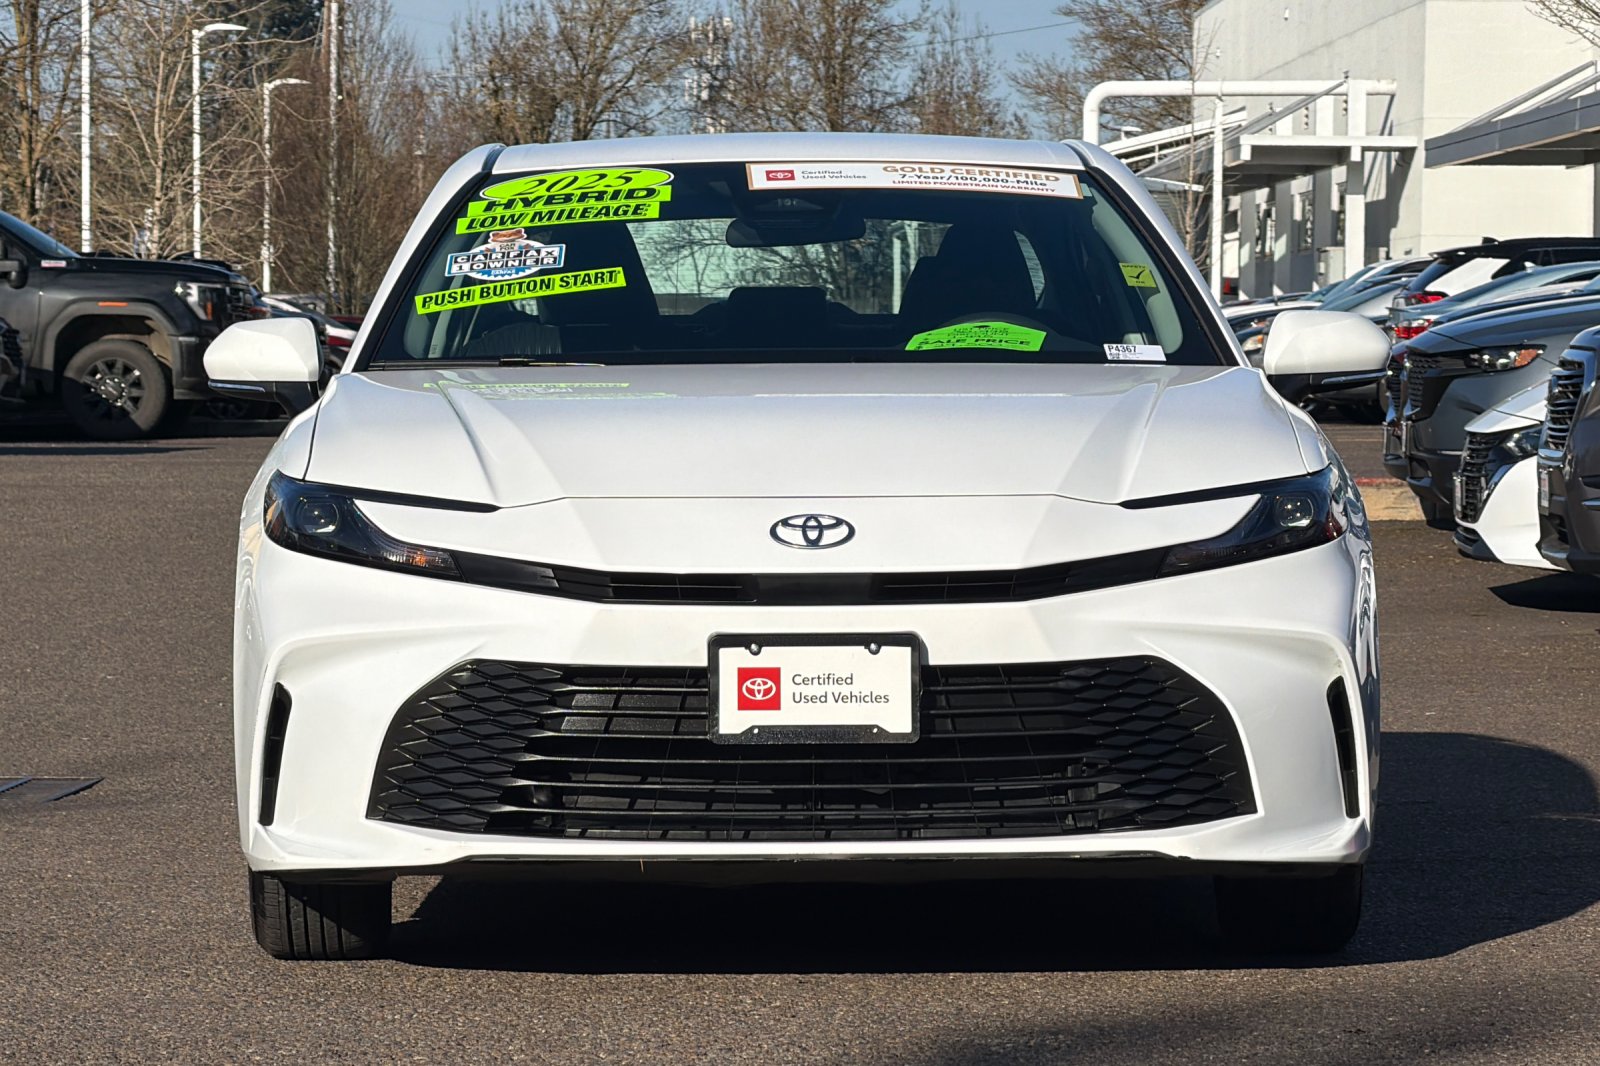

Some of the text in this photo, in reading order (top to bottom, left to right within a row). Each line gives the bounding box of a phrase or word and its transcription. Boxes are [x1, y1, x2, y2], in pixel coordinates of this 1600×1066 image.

[883, 165, 1060, 182] GOLD CERTIFIED
[513, 170, 643, 197] 2025
[1000, 184, 1056, 193] WARRANTY
[483, 186, 661, 214] HYBRID
[465, 203, 651, 232] LOW MILEAGE
[456, 248, 555, 263] CARFAX
[472, 257, 556, 270] OWNER
[421, 270, 622, 309] PUSH BUTTON START
[1107, 345, 1137, 353] P4367
[791, 673, 854, 686] Certified
[792, 691, 890, 704] Used Vehicles
